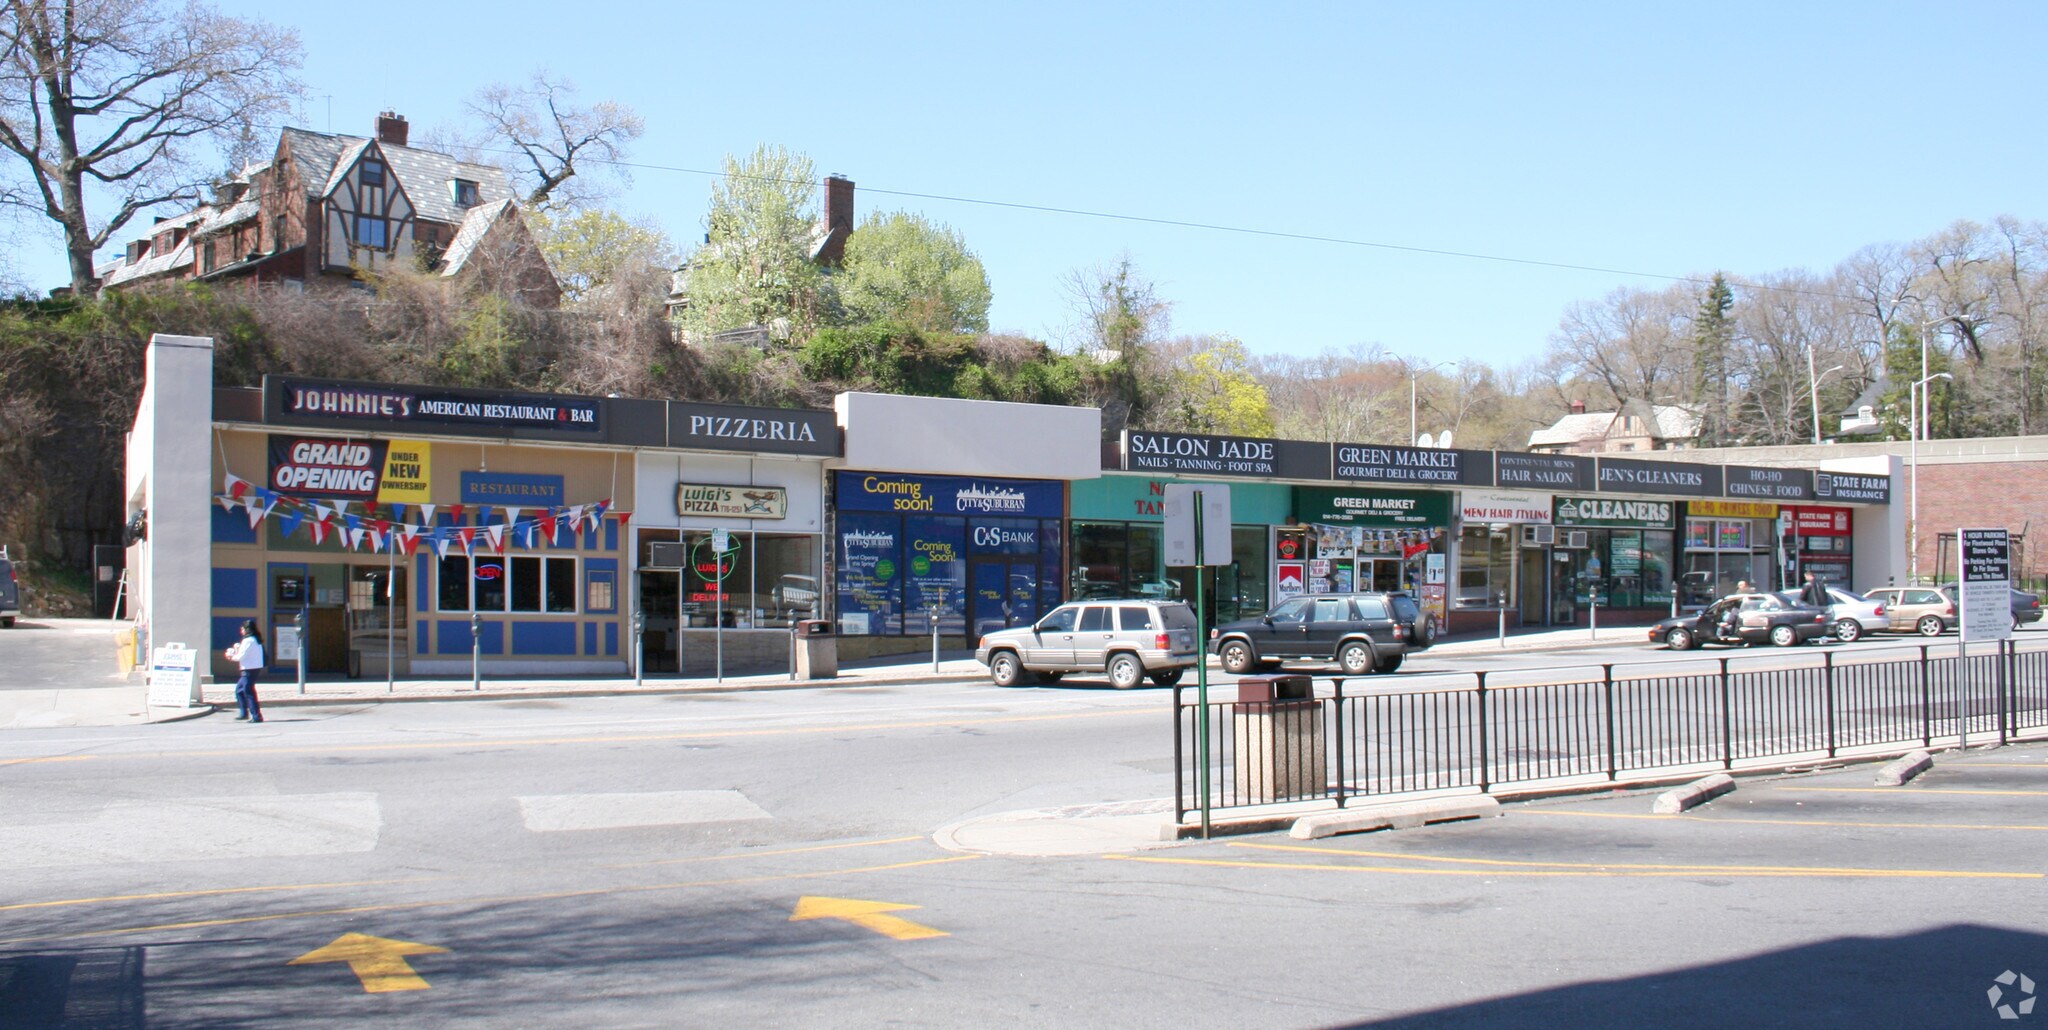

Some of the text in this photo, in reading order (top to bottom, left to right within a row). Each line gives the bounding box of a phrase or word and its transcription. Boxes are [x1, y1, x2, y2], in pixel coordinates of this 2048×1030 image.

[294, 389, 594, 423] JOHNNIE'S AMERICAN RESTAURANT & BAR
[690, 416, 816, 442] PIZZERIA
[292, 442, 371, 466] GRAND
[1132, 434, 1274, 460] SALON JADE
[391, 452, 419, 462] UNDER
[1138, 456, 1272, 473] NAILS TANNING FOOT SPA
[1339, 447, 1458, 468] GREEN MARKET
[1500, 457, 1575, 468] CONTINENTAL MEN'S
[389, 464, 420, 479] NEW
[1338, 466, 1458, 480] GOURMET DELI & GROCERY
[1502, 468, 1574, 483] HAIR SALON
[1600, 468, 1702, 486] JEN'S CLEANERS
[1750, 470, 1782, 482] HO-HO
[276, 468, 375, 492] OPENING
[382, 480, 427, 492] OWNERSHIP
[1832, 476, 1888, 490] STATE FARM
[470, 482, 556, 497] RESTAURANT
[864, 476, 922, 500] Coming
[1730, 482, 1802, 496] CHINESE FOOD
[1836, 489, 1884, 500] INSURANCE
[684, 501, 719, 513] PIZZA
[894, 495, 934, 511] soon!
[1333, 497, 1416, 510] GREEN MARKET
[1490, 508, 1512, 518] HAIR
[1515, 509, 1549, 520] STYLING
[1580, 500, 1670, 522] CLEANERS
[974, 526, 1034, 546] C&S BANK
[914, 539, 952, 554] Coming
[930, 550, 956, 562] Soon!
[474, 566, 501, 578] OPEN
[1278, 582, 1302, 592] Marlboro
[692, 593, 730, 602] DELIVR
